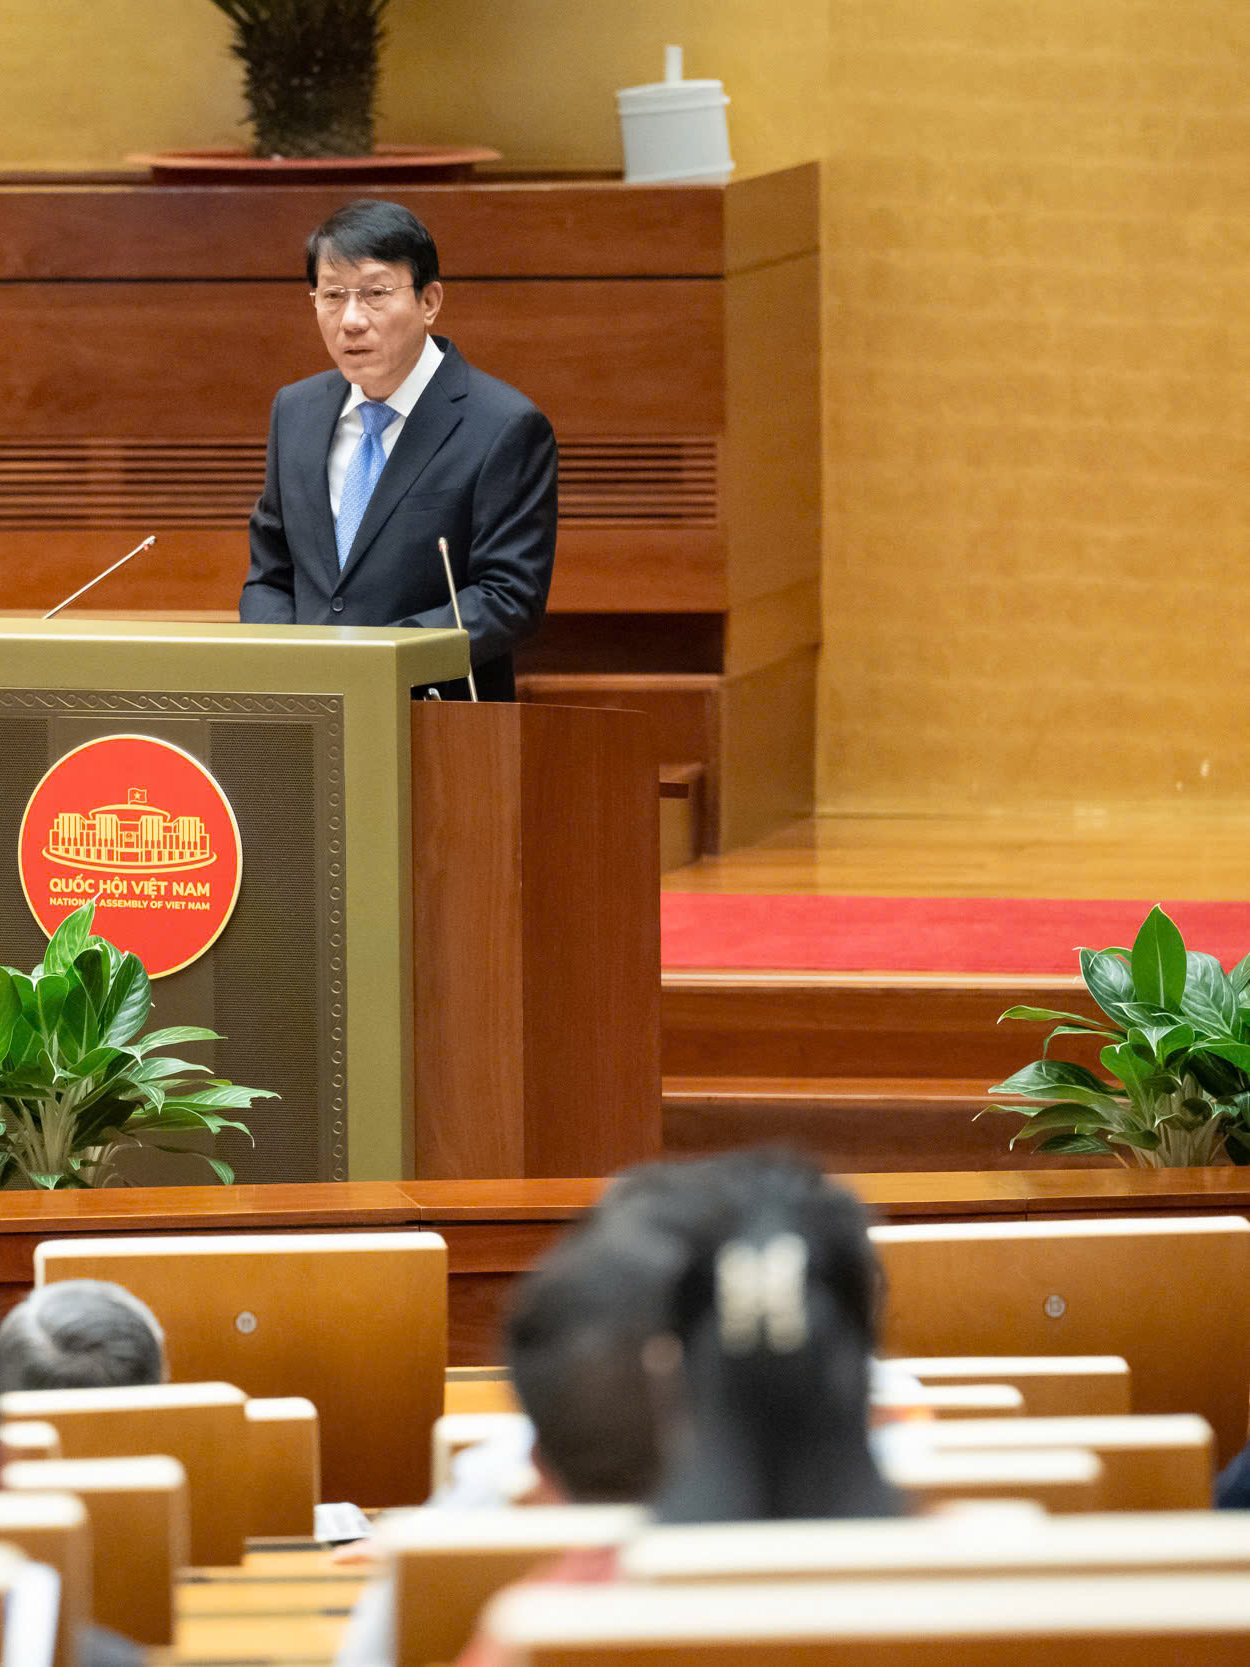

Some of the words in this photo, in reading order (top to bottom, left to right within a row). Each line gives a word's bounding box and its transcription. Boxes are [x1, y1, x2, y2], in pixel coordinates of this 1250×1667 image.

[49, 873, 95, 893] QUỐC
[99, 876, 128, 898] HỘI
[131, 877, 168, 899] VIỆT
[172, 881, 210, 897] NAM
[49, 896, 97, 908] NATIONA
[99, 898, 149, 909] ASSEMBLY
[150, 901, 164, 909] OF
[165, 901, 187, 910] VIET
[188, 902, 210, 911] NAM
